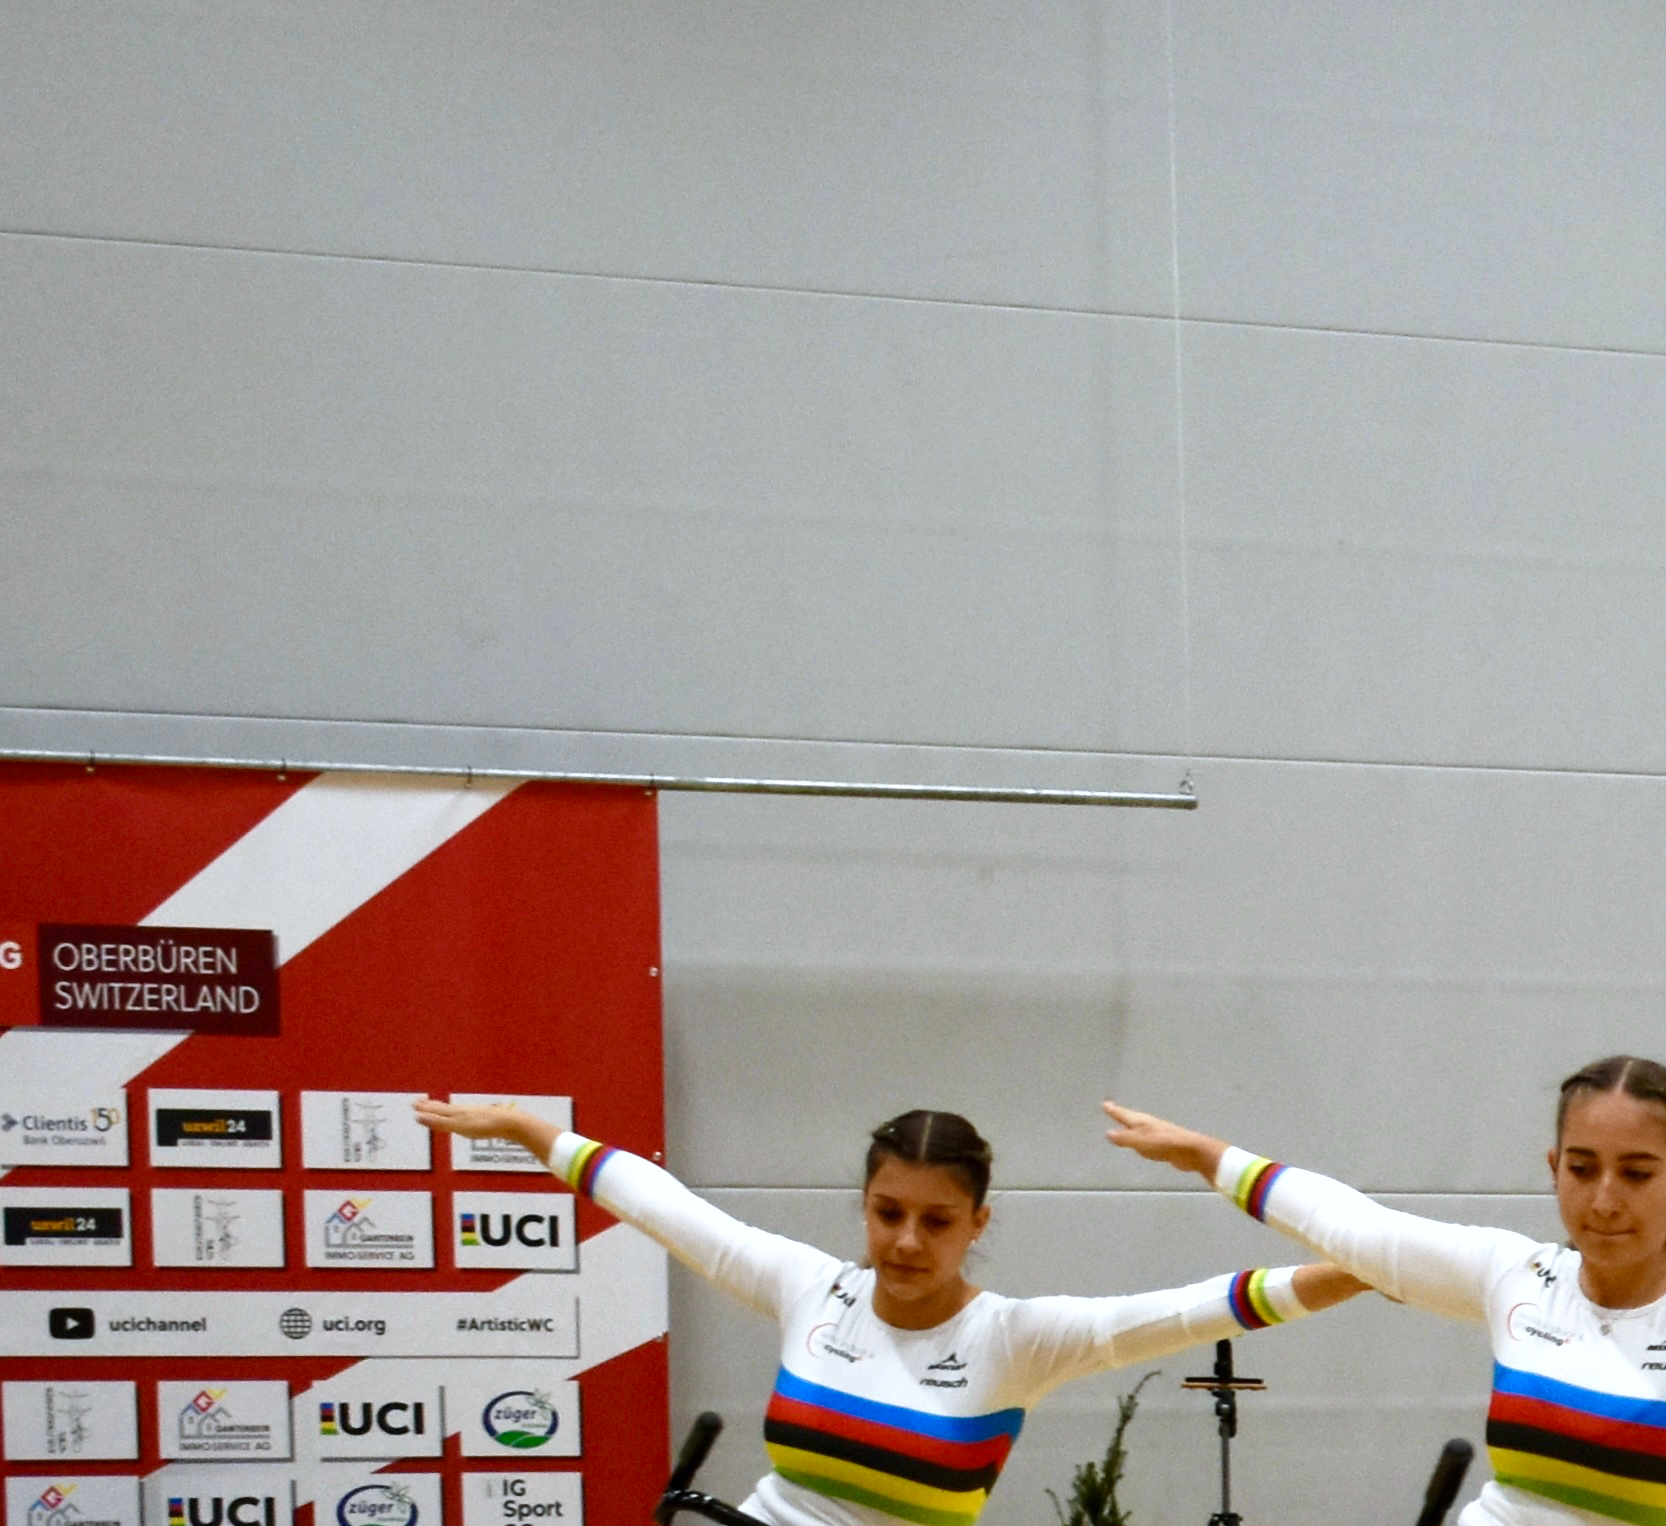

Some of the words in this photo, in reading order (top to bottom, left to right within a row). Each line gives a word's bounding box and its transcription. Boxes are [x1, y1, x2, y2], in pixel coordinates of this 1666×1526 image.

[53, 938, 238, 974] OBERBÜREN
[55, 981, 260, 1014] SWITZERLAND
[22, 1115, 88, 1131] Clientis
[480, 1212, 560, 1247] UCI
[109, 1317, 207, 1332] ucichannel
[323, 1316, 386, 1335] uci.org
[456, 1318, 555, 1332] #ArtisticWC
[338, 1402, 425, 1435] UCI
[494, 1407, 538, 1424] züger
[502, 1479, 527, 1497] IG
[349, 1500, 394, 1516] züger
[503, 1500, 563, 1521] Sport
